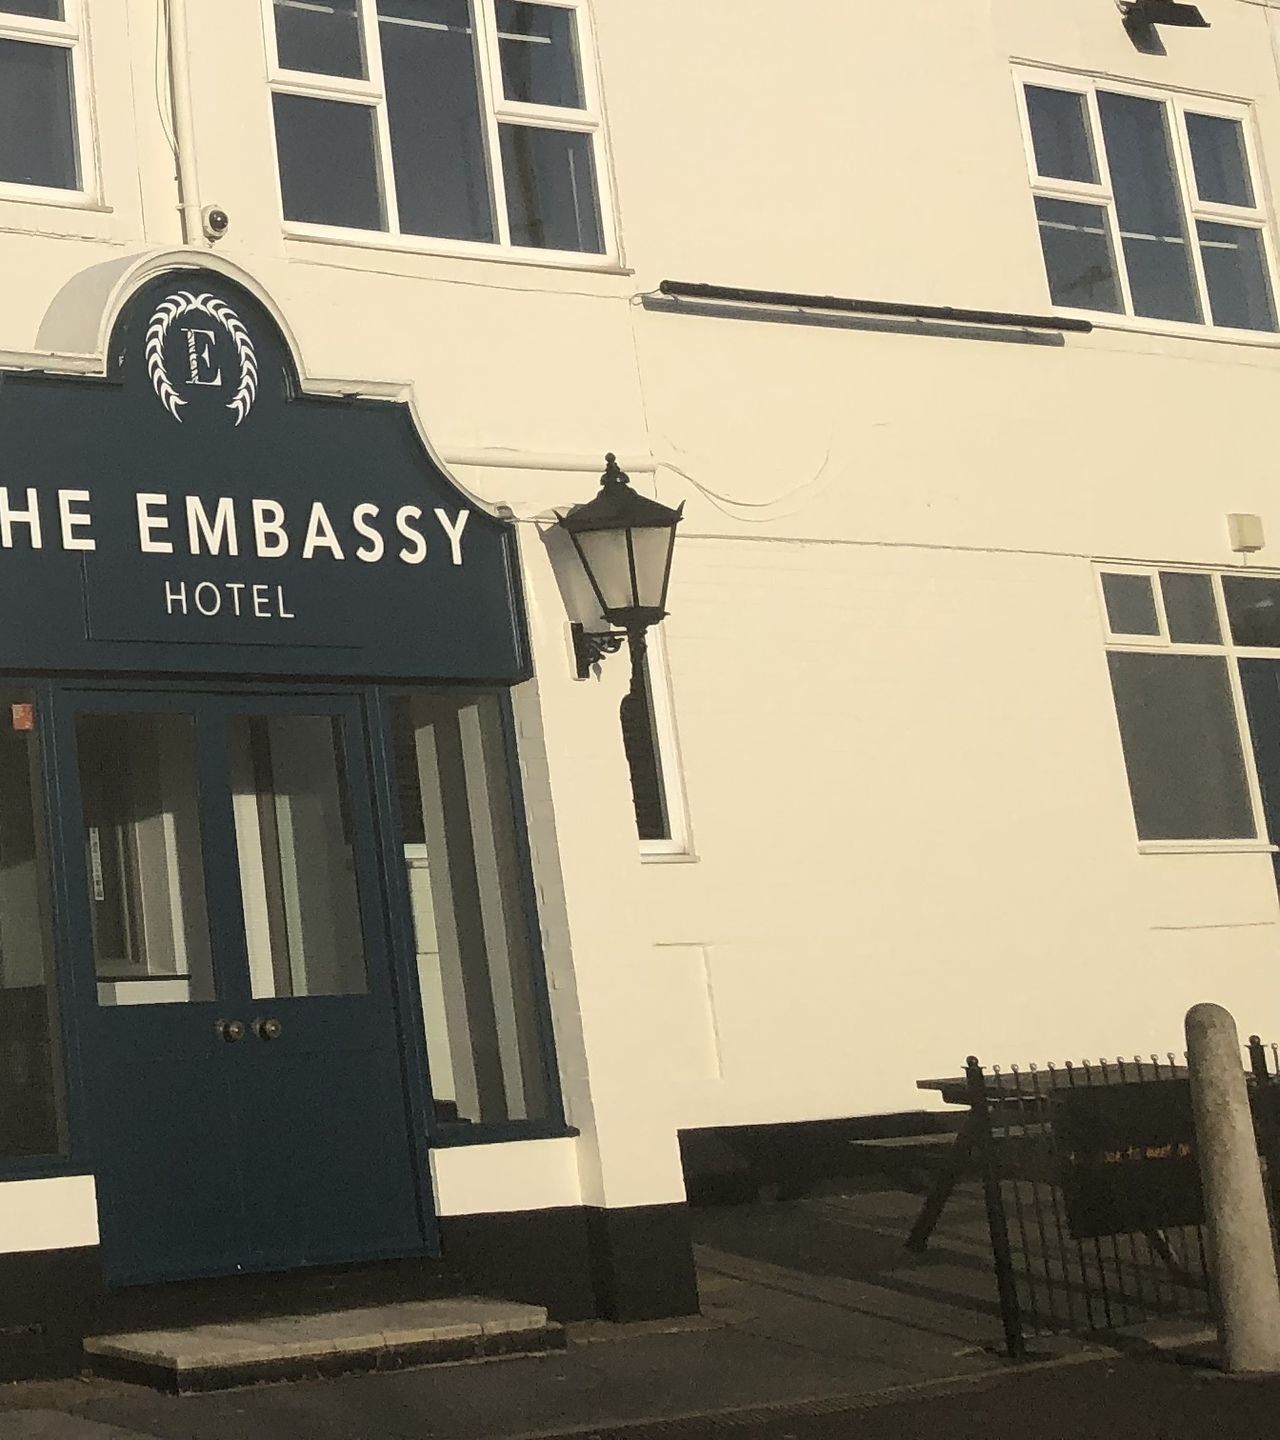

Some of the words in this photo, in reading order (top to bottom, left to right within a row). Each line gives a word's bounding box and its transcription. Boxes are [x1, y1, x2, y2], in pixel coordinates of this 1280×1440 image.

[181, 328, 222, 387] E
[135, 492, 470, 566] EMBASSY
[165, 580, 296, 620] HOTEL
